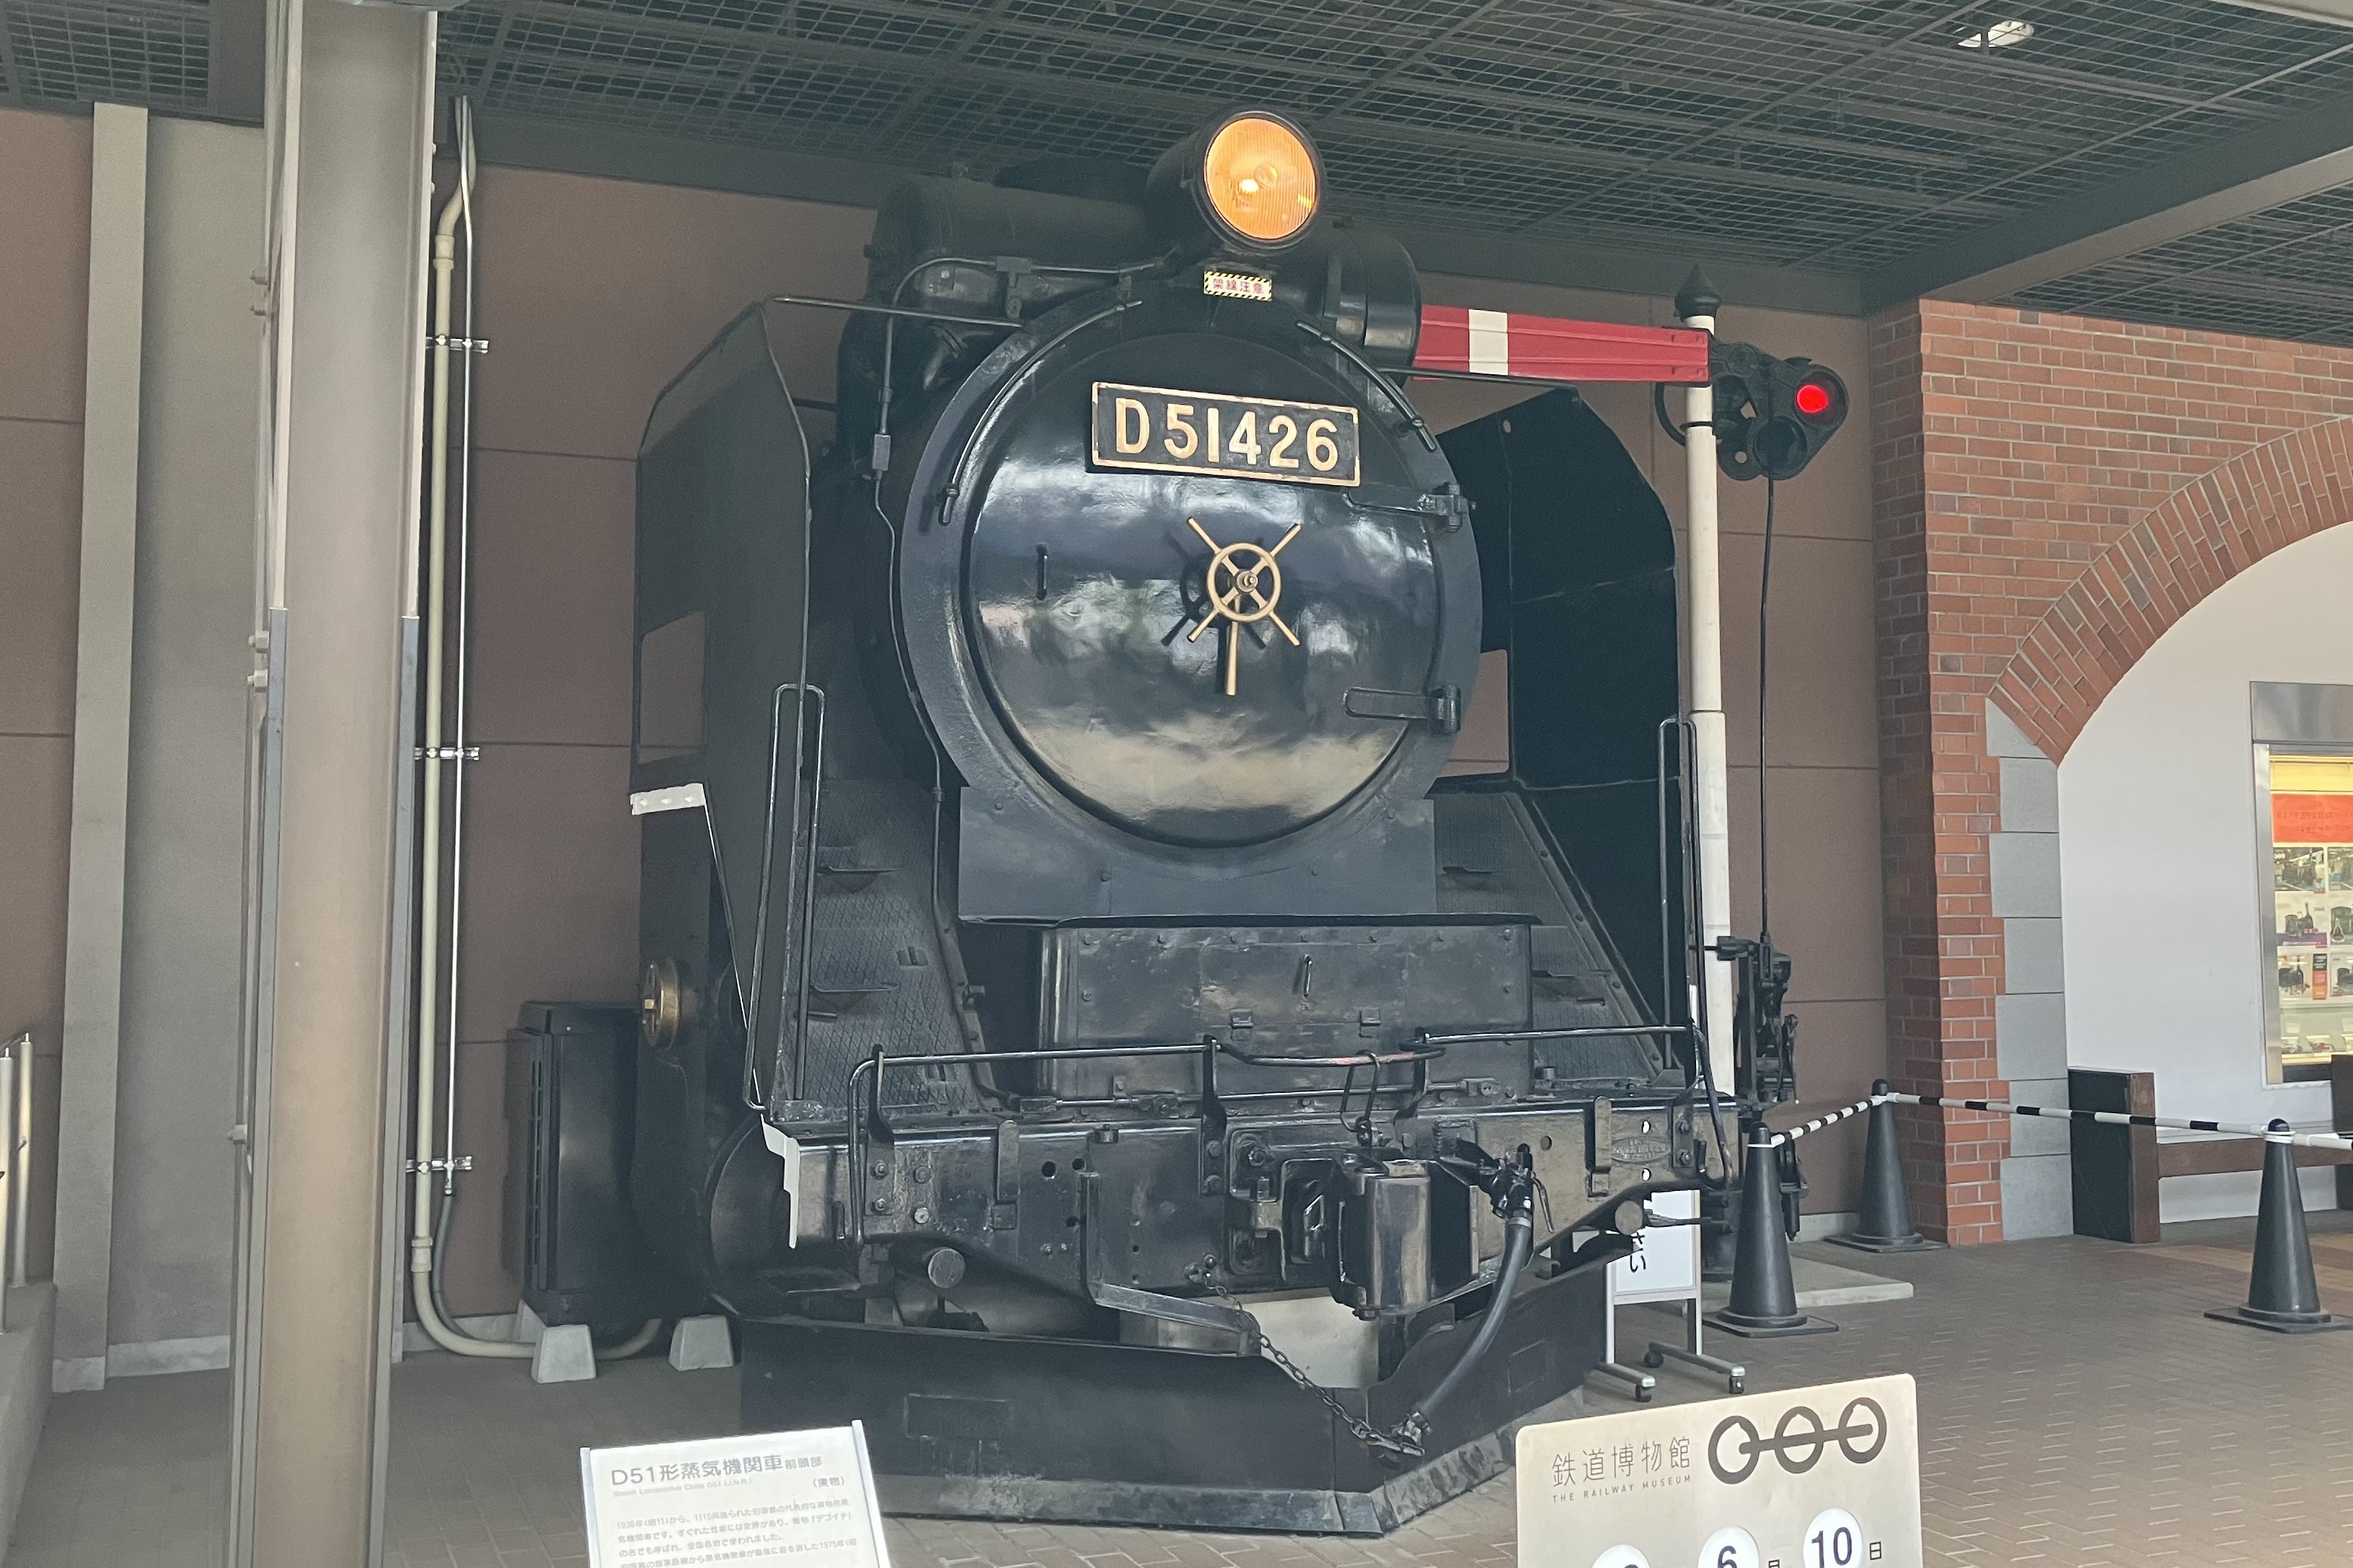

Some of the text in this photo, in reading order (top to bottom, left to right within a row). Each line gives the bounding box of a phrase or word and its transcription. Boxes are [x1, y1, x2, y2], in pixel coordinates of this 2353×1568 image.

[1213, 278, 1263, 294] 架線注意
[1552, 1436, 1690, 1487] 鉄道博物館
[1553, 1474, 1691, 1504] THE RAILWAY MUSEUM
[1811, 1526, 1853, 1568] 10
[1869, 1541, 1882, 1560] 日
